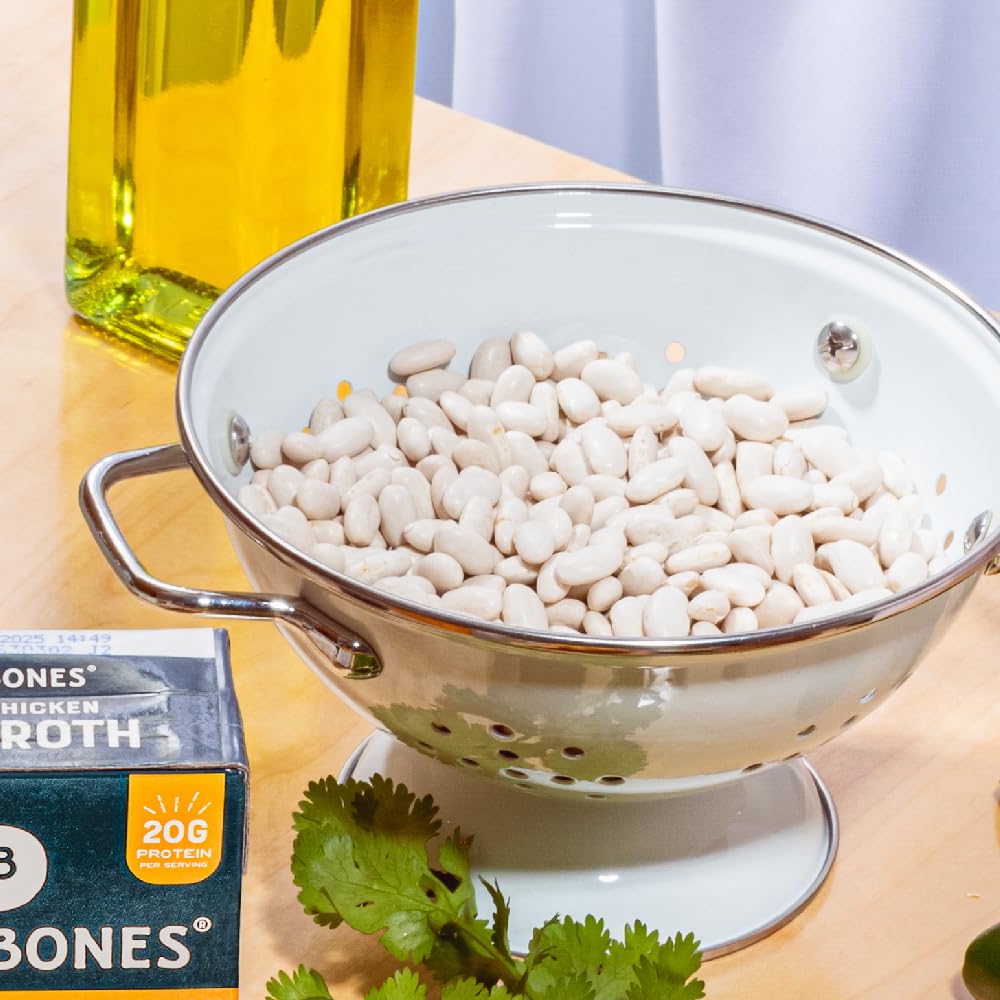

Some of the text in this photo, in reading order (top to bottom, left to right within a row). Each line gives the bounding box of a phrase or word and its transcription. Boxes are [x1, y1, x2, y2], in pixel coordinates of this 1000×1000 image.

[0, 633, 45, 644] 2025
[56, 633, 112, 644] 14:49
[142, 819, 209, 844] 20G
[136, 847, 212, 859] PROTEIN
[139, 860, 209, 869] PER SERVING
